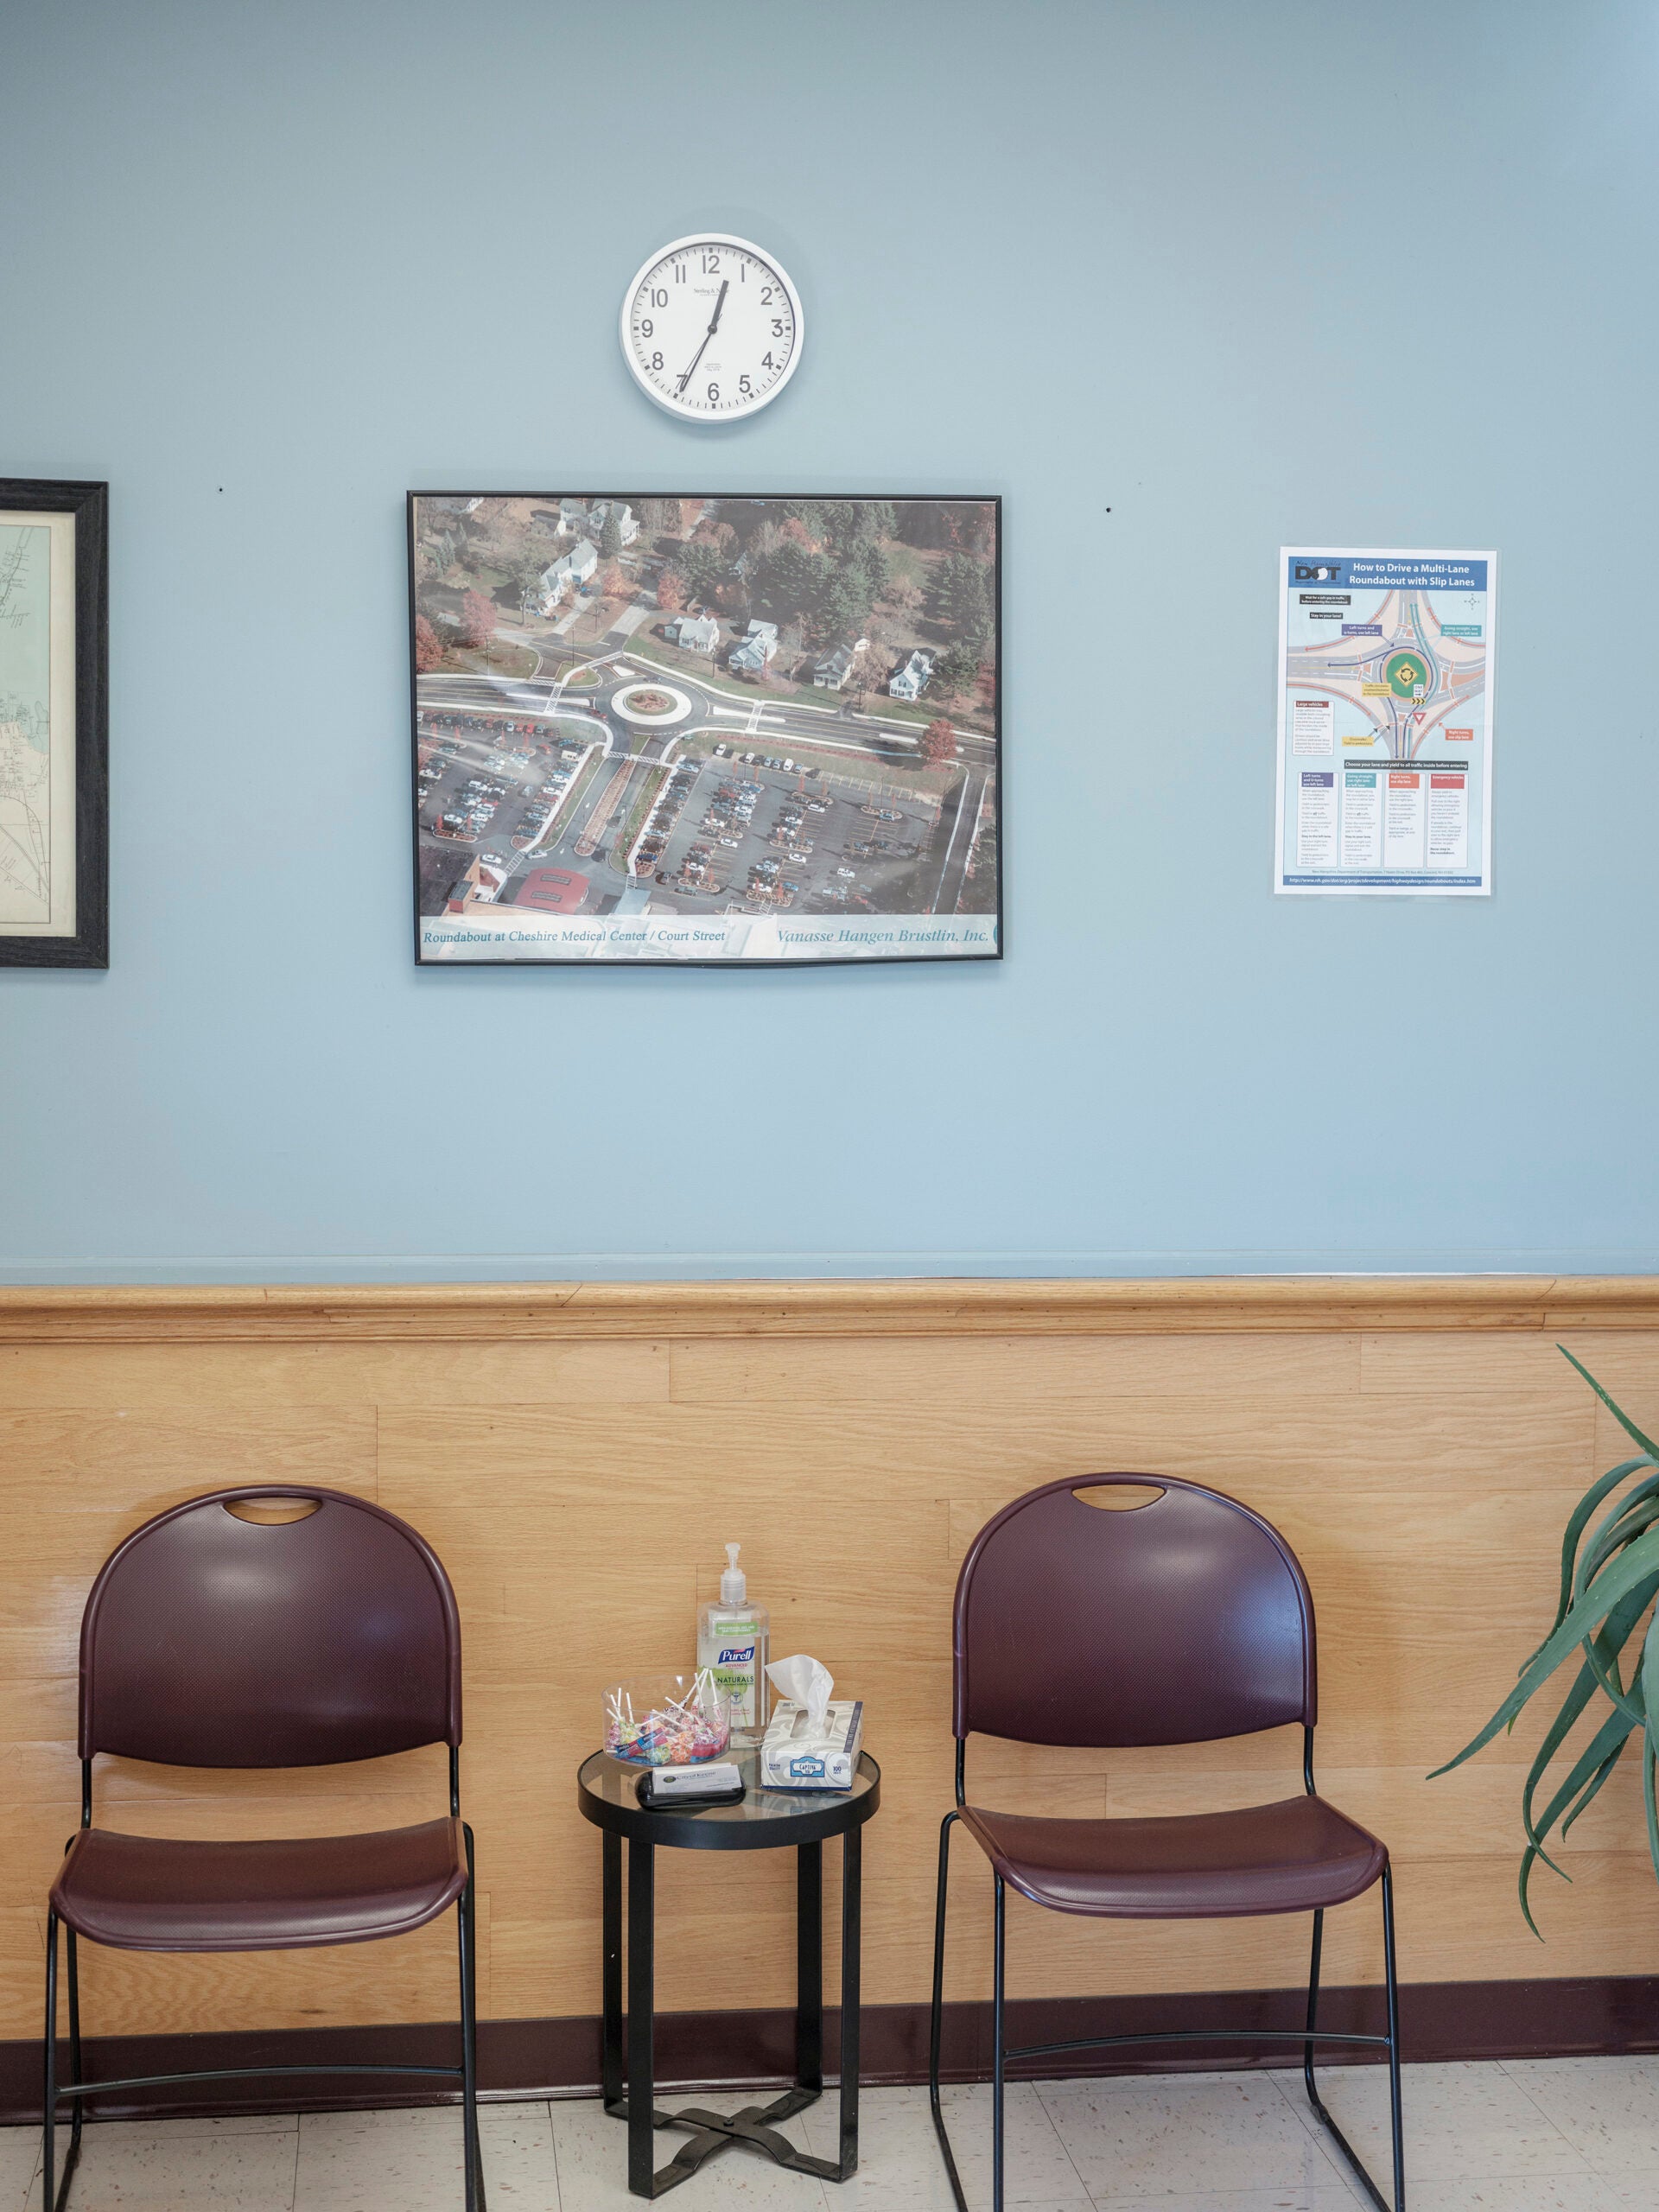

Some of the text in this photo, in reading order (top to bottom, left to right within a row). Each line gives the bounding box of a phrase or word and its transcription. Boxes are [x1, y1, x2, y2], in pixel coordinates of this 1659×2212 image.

[675, 264, 686, 283] 11
[702, 255, 721, 274] 12
[741, 264, 745, 283] 1
[651, 289, 669, 308] 10
[760, 287, 772, 305] 2
[641, 319, 653, 338] 9
[771, 319, 784, 337] 3
[652, 352, 664, 370] 8
[761, 352, 773, 370] 4
[677, 374, 689, 391] 7
[739, 375, 751, 393] 5
[708, 383, 720, 401] 6
[1295, 566, 1341, 581] DOT
[1353, 563, 1373, 572] How
[1387, 563, 1411, 572] Drive
[1421, 564, 1470, 574] Multi-Lane
[1350, 576, 1406, 585] Roundabout
[1408, 576, 1427, 586] with
[1429, 577, 1446, 588] Slip
[1449, 577, 1475, 587] Lanes
[423, 930, 726, 943] Roundabout at Cheshire Medical Center / Court Street
[778, 930, 988, 945] Vanasse Hangen Brustlin, Inc.
[722, 1649, 752, 1661] Purell
